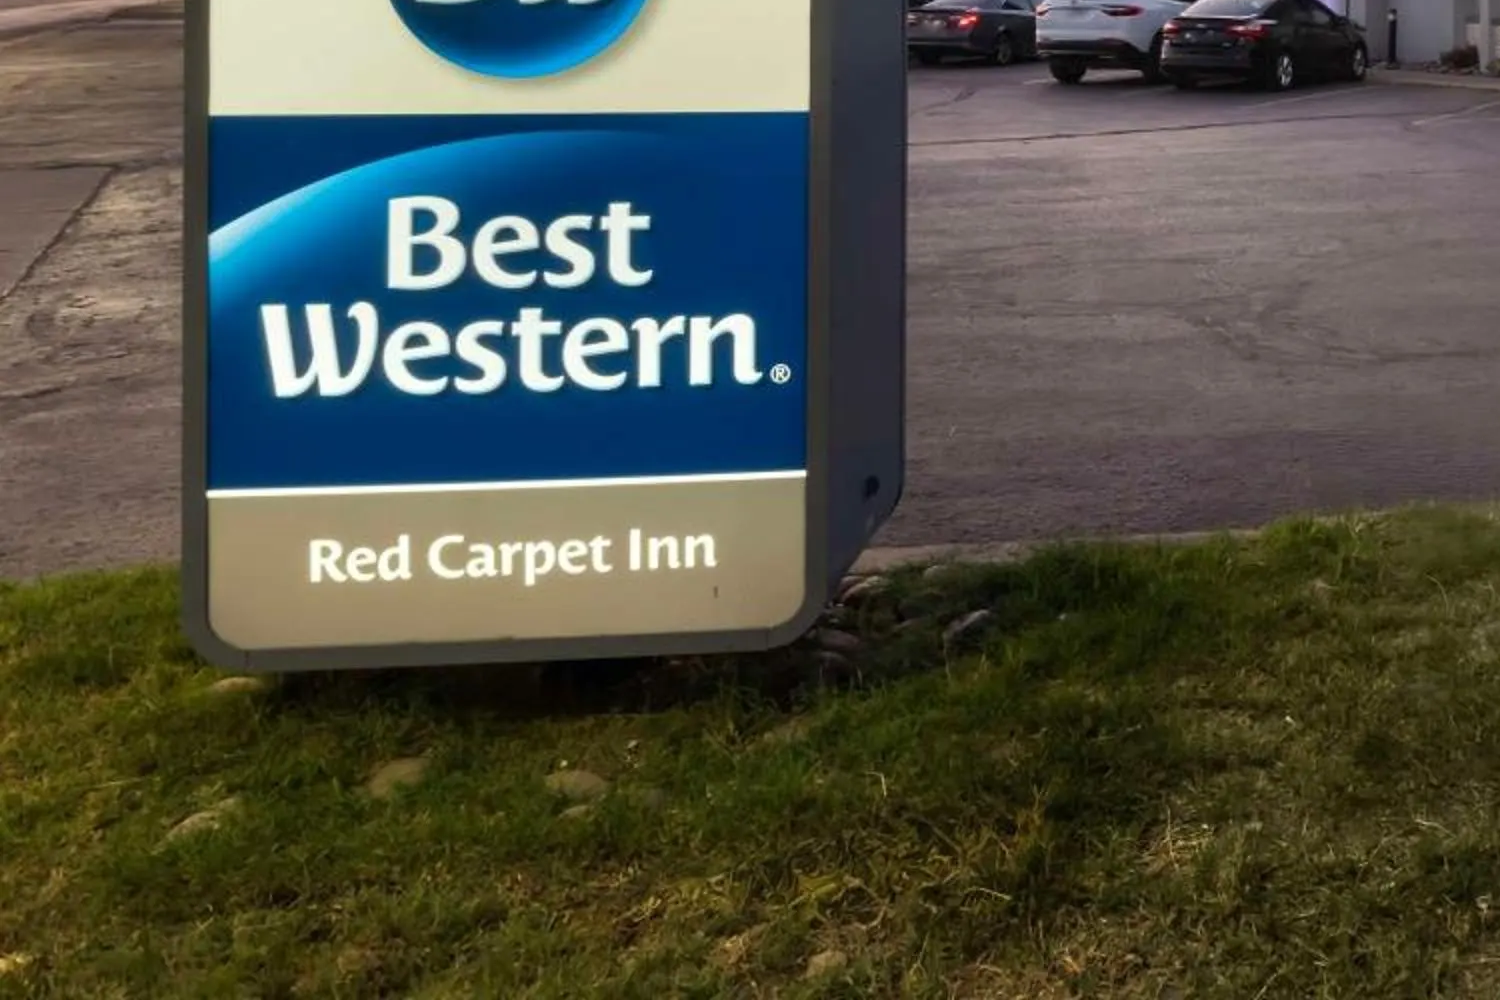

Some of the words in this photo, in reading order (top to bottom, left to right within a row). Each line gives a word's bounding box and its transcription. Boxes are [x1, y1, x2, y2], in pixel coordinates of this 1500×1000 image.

[387, 195, 653, 290] Best
[308, 533, 413, 584] Red
[426, 533, 614, 587] Carpet
[628, 527, 718, 572] Inn
